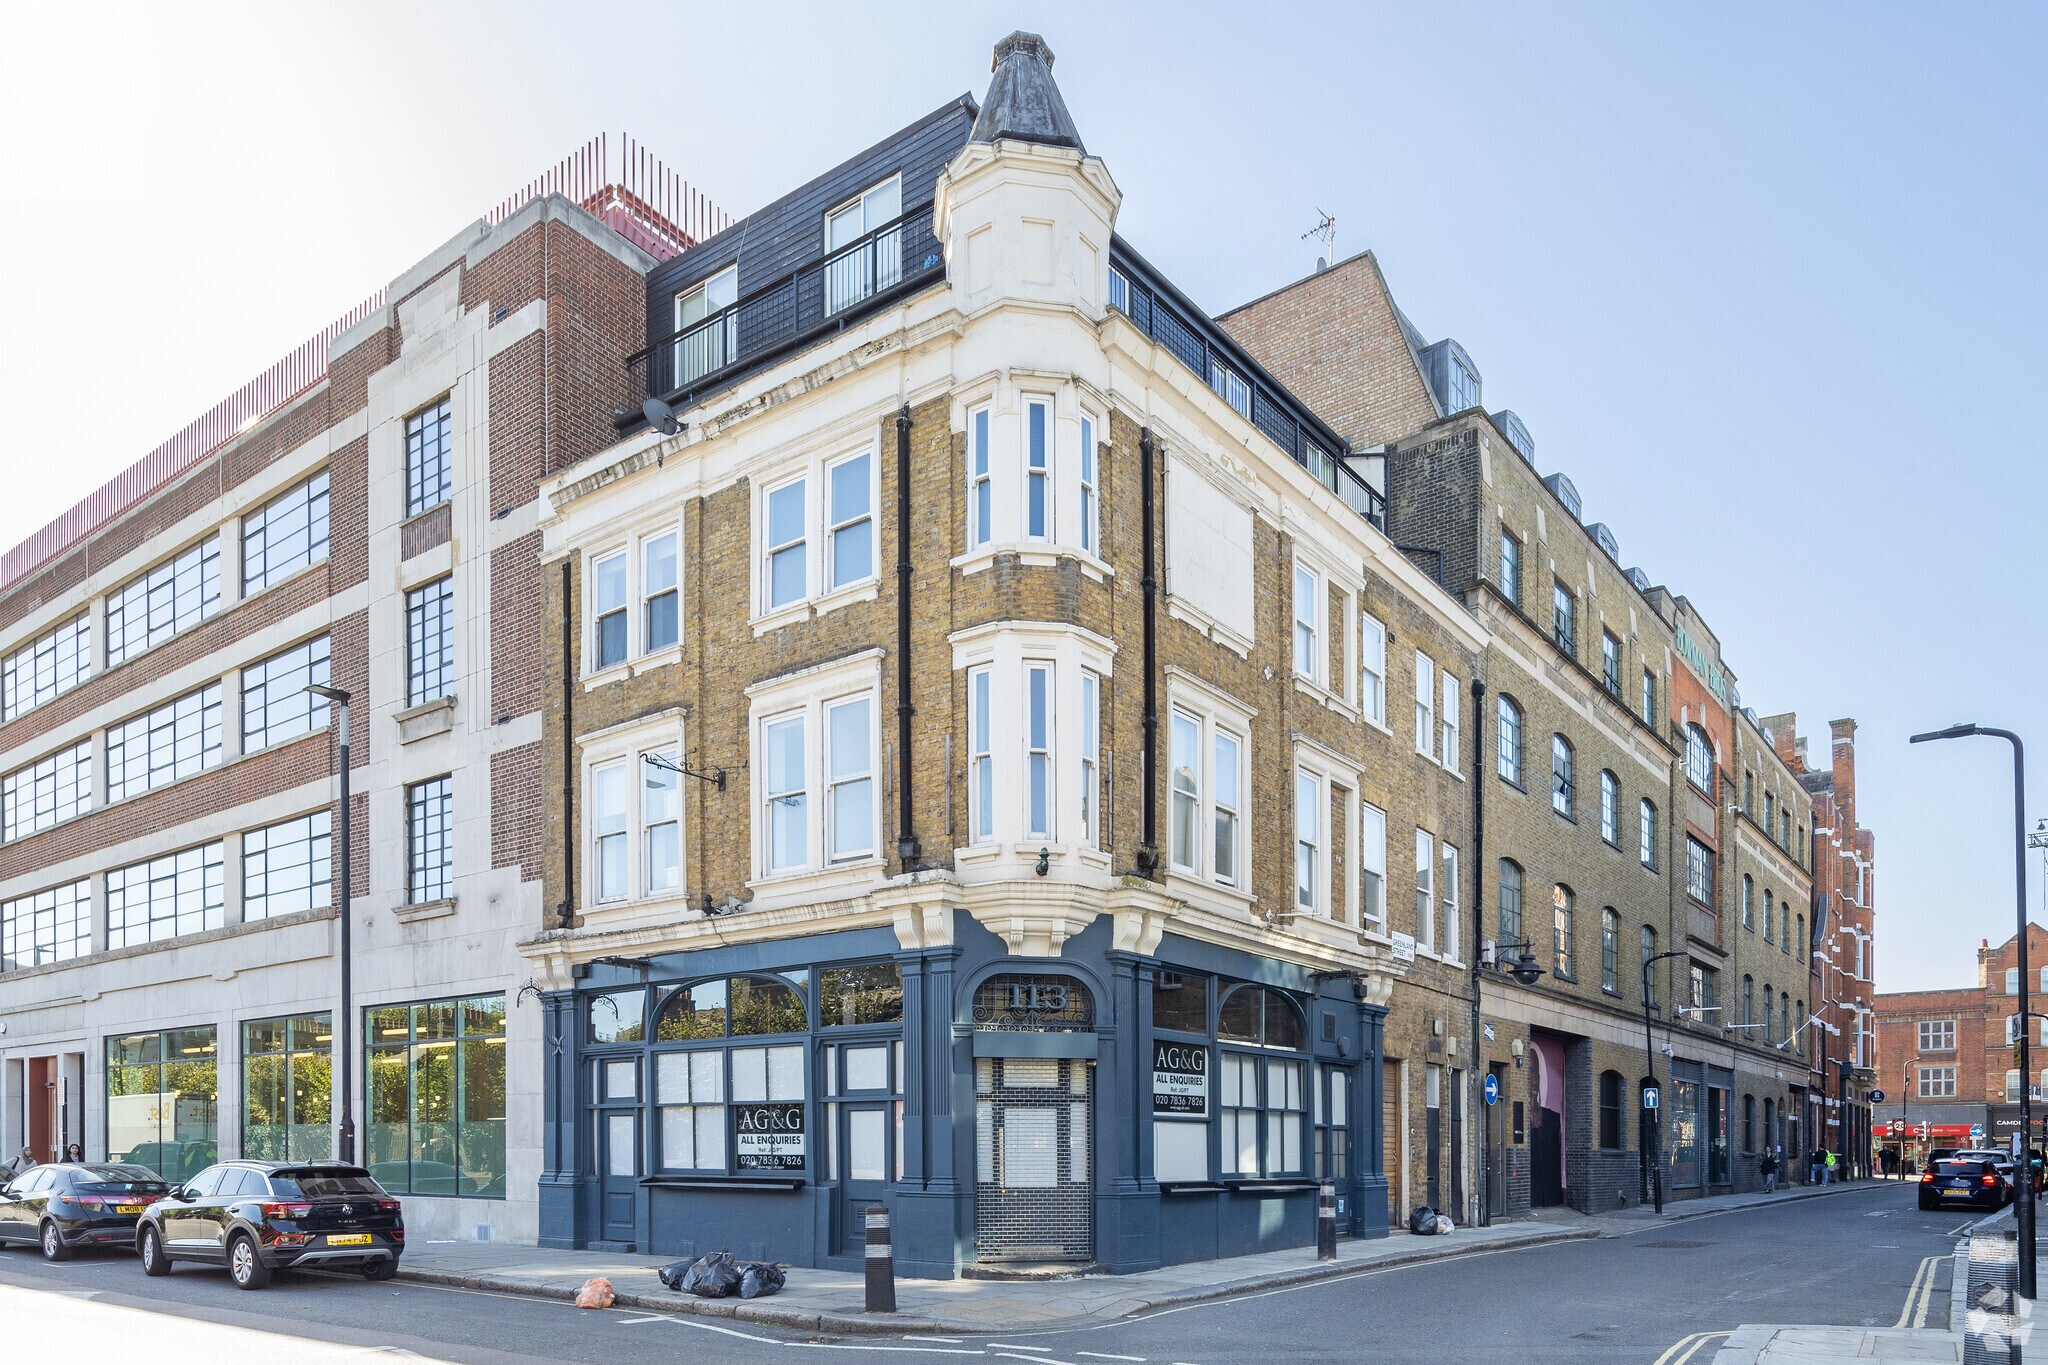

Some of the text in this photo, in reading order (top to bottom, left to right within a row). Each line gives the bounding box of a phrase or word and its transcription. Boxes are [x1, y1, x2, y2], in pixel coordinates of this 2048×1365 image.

[1676, 623, 1707, 678] BOWMAN
[1392, 946, 1406, 957] STREET
[1010, 983, 1067, 1010] 113
[1156, 1046, 1203, 1071] AG&G
[1156, 1073, 1203, 1086] ALL ENQUIRIES
[1155, 1095, 1203, 1106] 020 7836 7826
[740, 1108, 801, 1130] AG&G
[740, 1135, 801, 1146] ALL ENQUIRIES
[740, 1155, 802, 1165] 020 7836 7826
